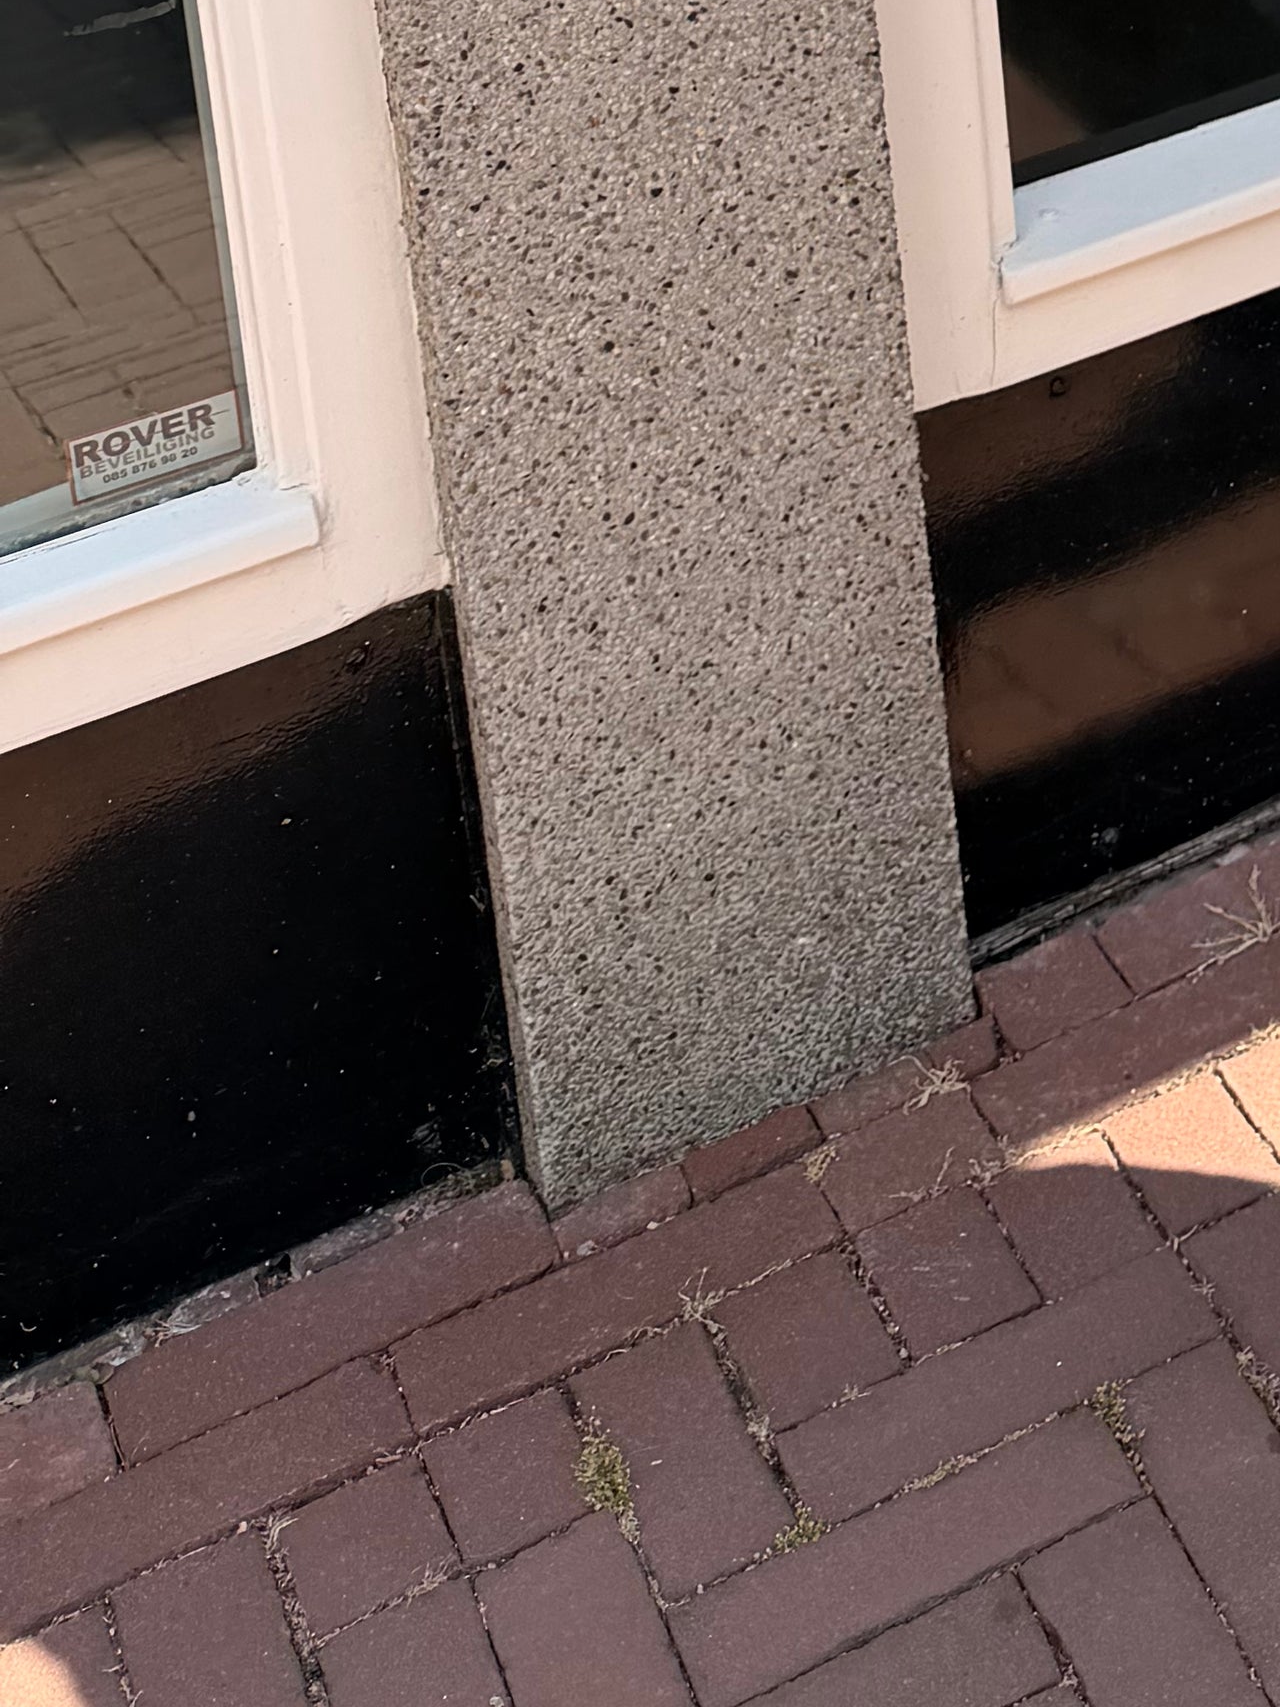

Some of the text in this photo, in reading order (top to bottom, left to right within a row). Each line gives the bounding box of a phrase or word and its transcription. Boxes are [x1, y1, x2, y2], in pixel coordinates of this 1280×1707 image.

[73, 403, 215, 468] ROVER
[80, 426, 215, 479] BEVEILIGING
[103, 472, 127, 484] 085
[181, 445, 198, 459] 20
